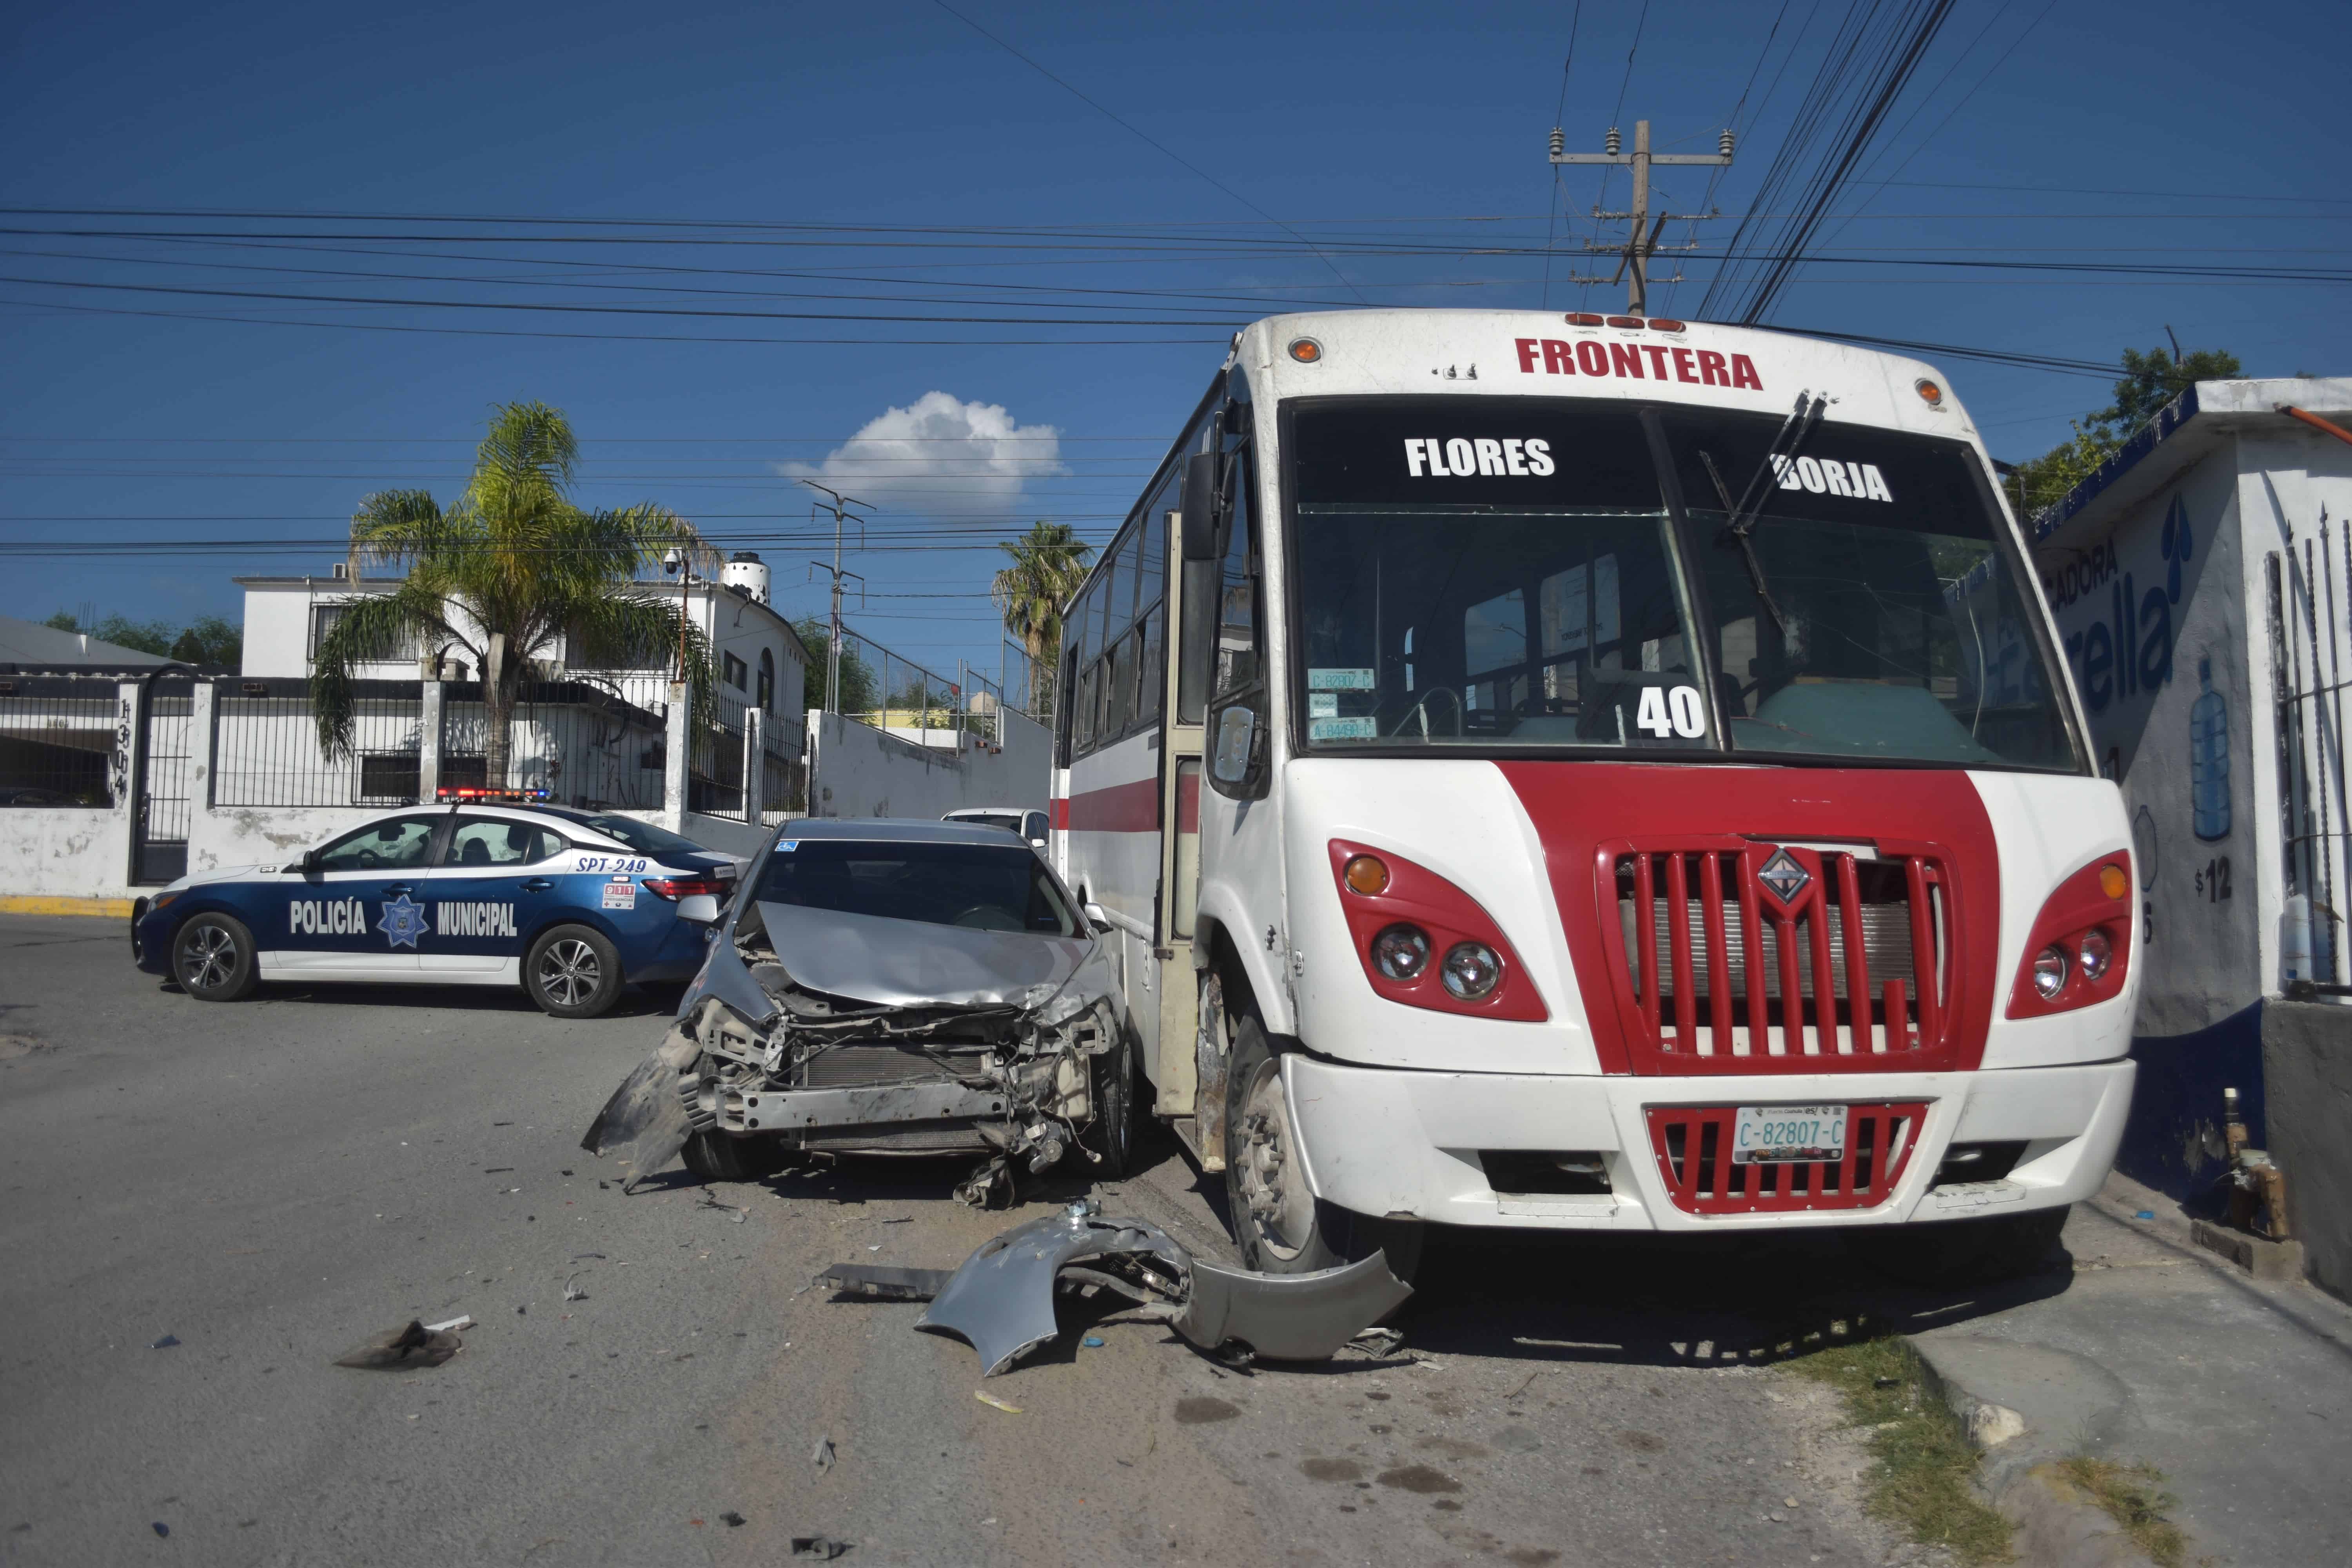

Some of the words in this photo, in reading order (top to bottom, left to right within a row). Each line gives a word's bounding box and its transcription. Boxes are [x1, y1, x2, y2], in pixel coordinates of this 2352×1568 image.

[1515, 338, 1764, 391] FRONTERA
[1404, 438, 1555, 477] FLORES
[1769, 454, 1893, 502] BORJA
[1313, 675, 1369, 687] C-82807-C
[1637, 686, 1705, 738] 40
[576, 857, 647, 872] SPT-249
[291, 897, 367, 934] POLICÍA
[437, 902, 517, 936] MUNICIPAL
[1740, 1120, 1842, 1147] C-82807-C
